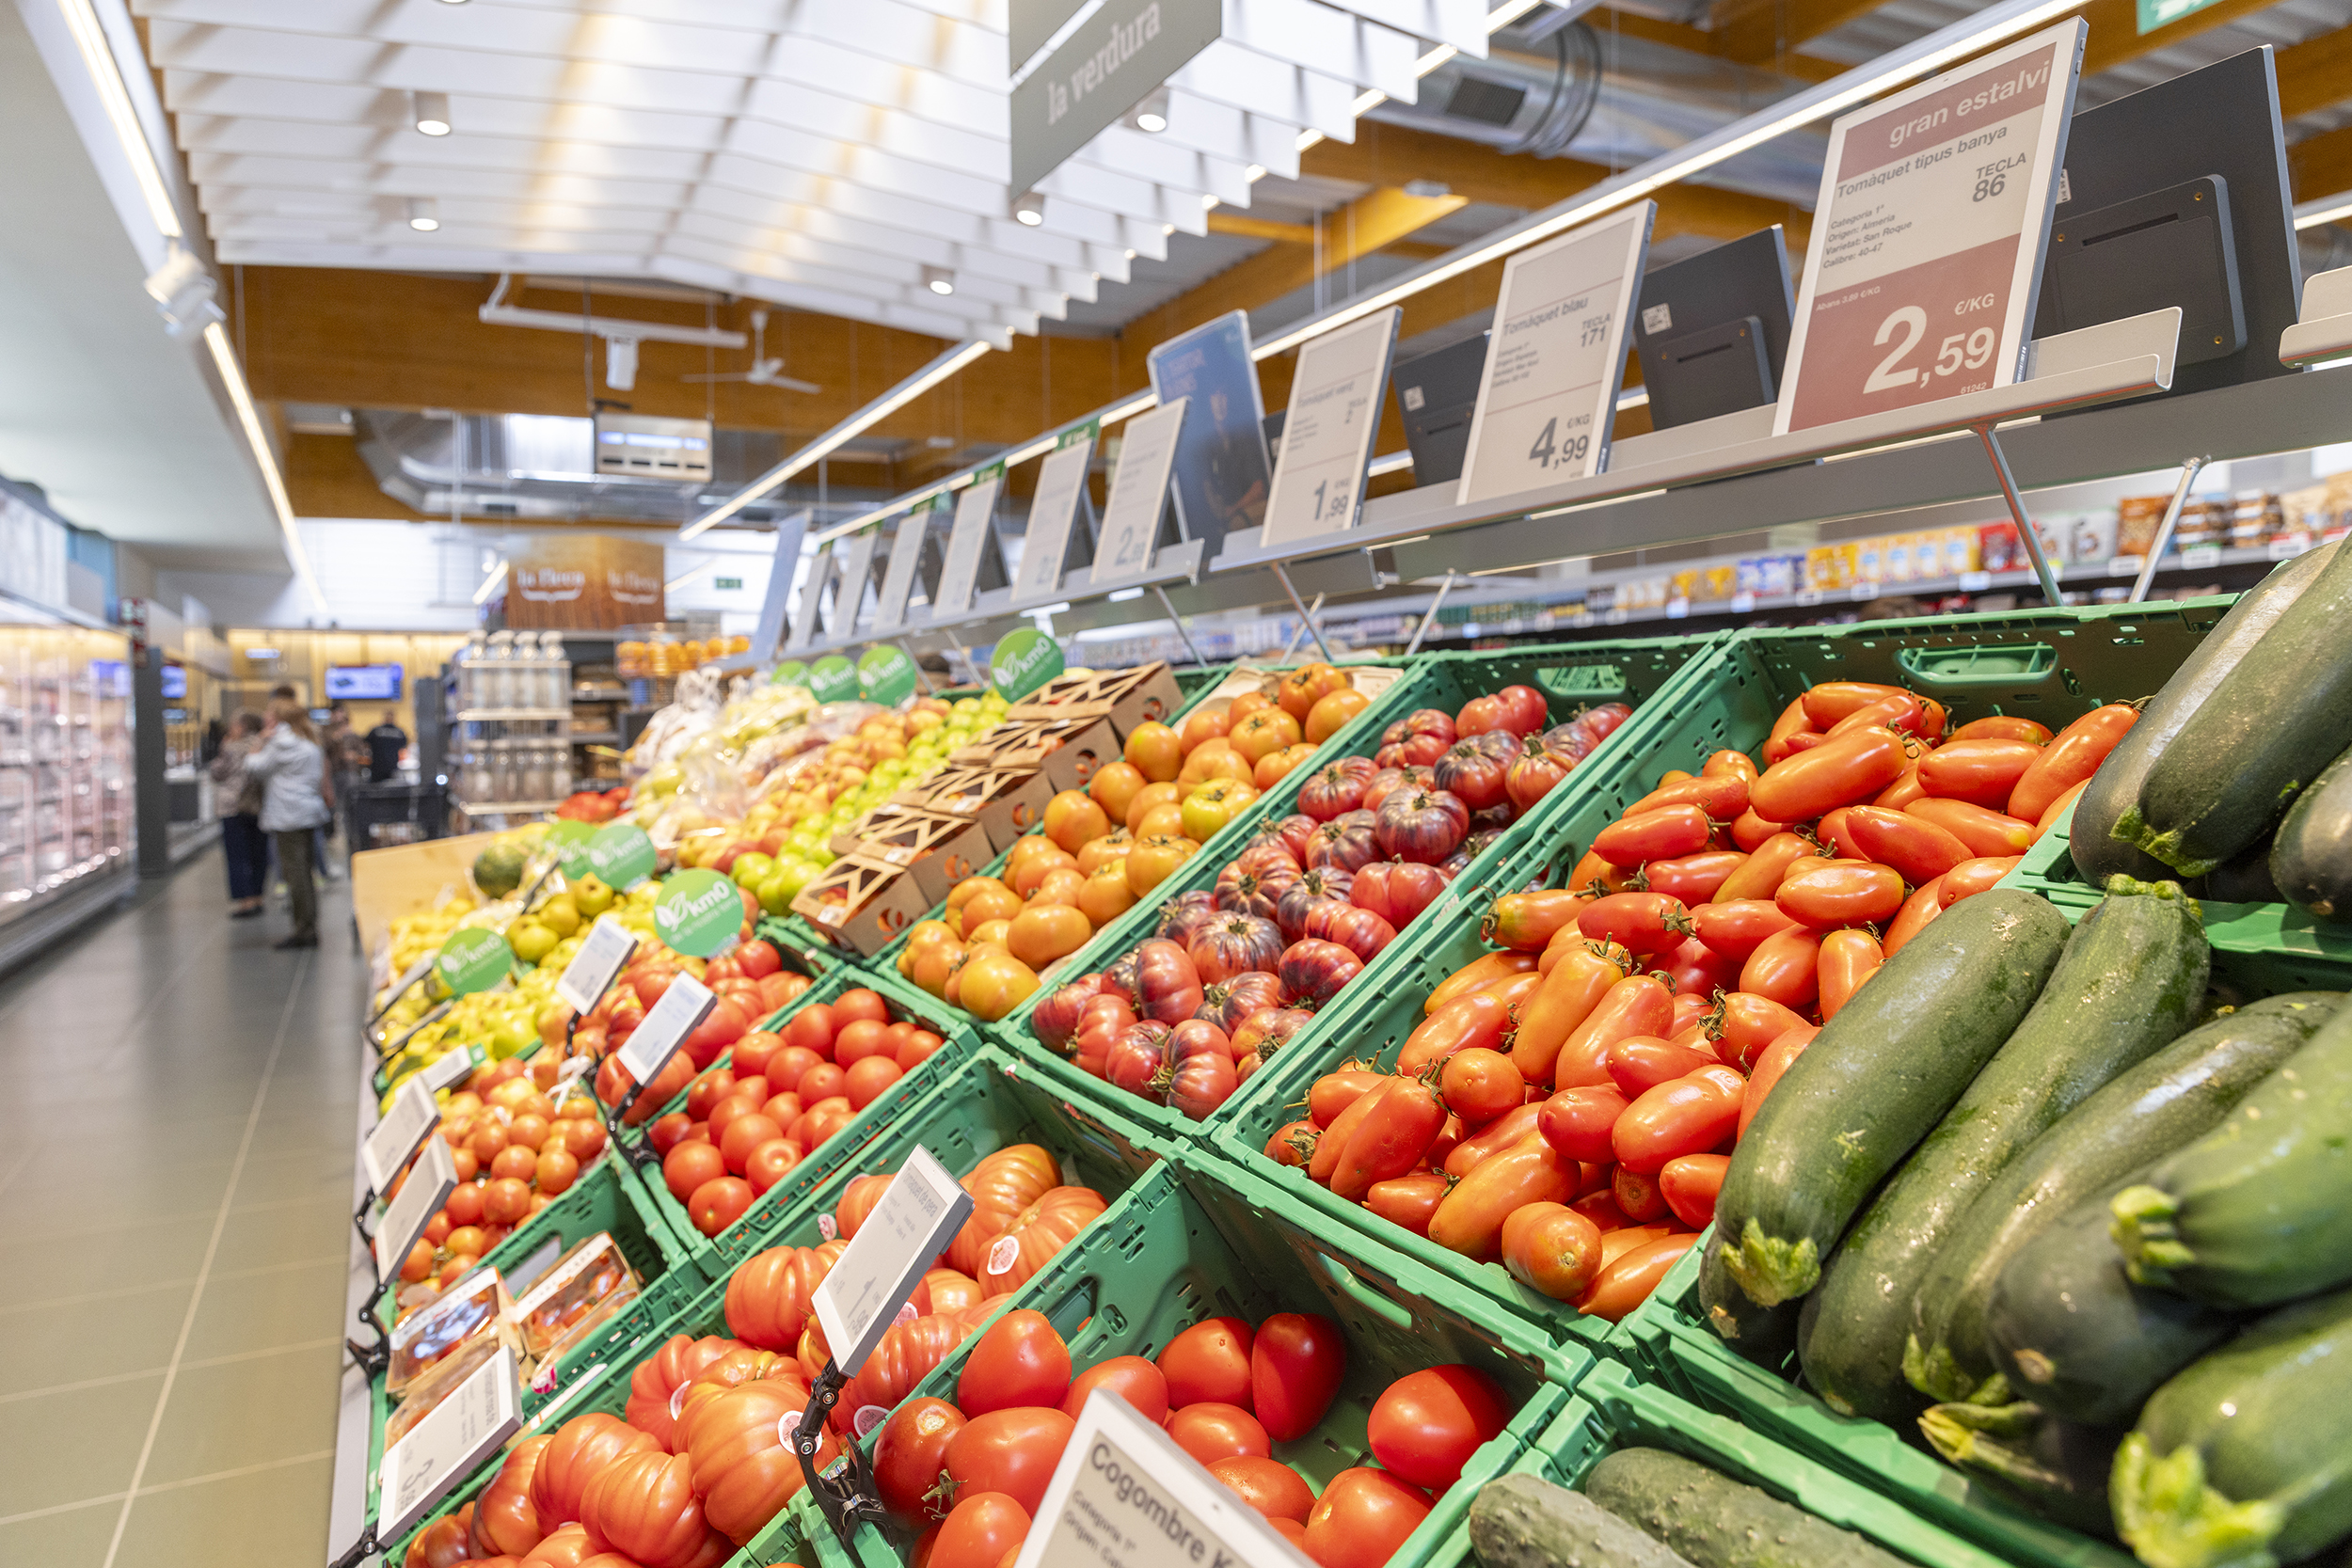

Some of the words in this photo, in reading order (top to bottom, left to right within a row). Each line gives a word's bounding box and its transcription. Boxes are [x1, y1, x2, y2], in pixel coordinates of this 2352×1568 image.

[1047, 80, 1069, 126] la
[1071, 1, 1161, 103] verdura
[1889, 107, 1948, 149] gran
[1956, 60, 2050, 117] estalvi
[1837, 162, 1911, 198] Tomàquet
[1915, 147, 1952, 169] tipus
[1957, 126, 2007, 154] banya
[1975, 152, 2026, 179] TECLA
[1972, 173, 2006, 202] 86
[1828, 227, 1860, 243] Origen:
[1831, 210, 1872, 230] Categoria
[1825, 238, 1861, 255] Varietat:
[1863, 232, 1881, 243] San
[1882, 222, 1913, 237] Roque
[1823, 254, 1856, 268] Calibre:
[1858, 242, 1883, 257] 40-47
[1954, 293, 1994, 316] €/KG
[1581, 325, 1607, 348] 171
[1862, 305, 1995, 394] 2,59
[1529, 417, 1589, 470] 4,99
[686, 880, 730, 918] km0
[922, 1197, 938, 1218] pera
[1089, 1441, 1206, 1563] Cogombre
